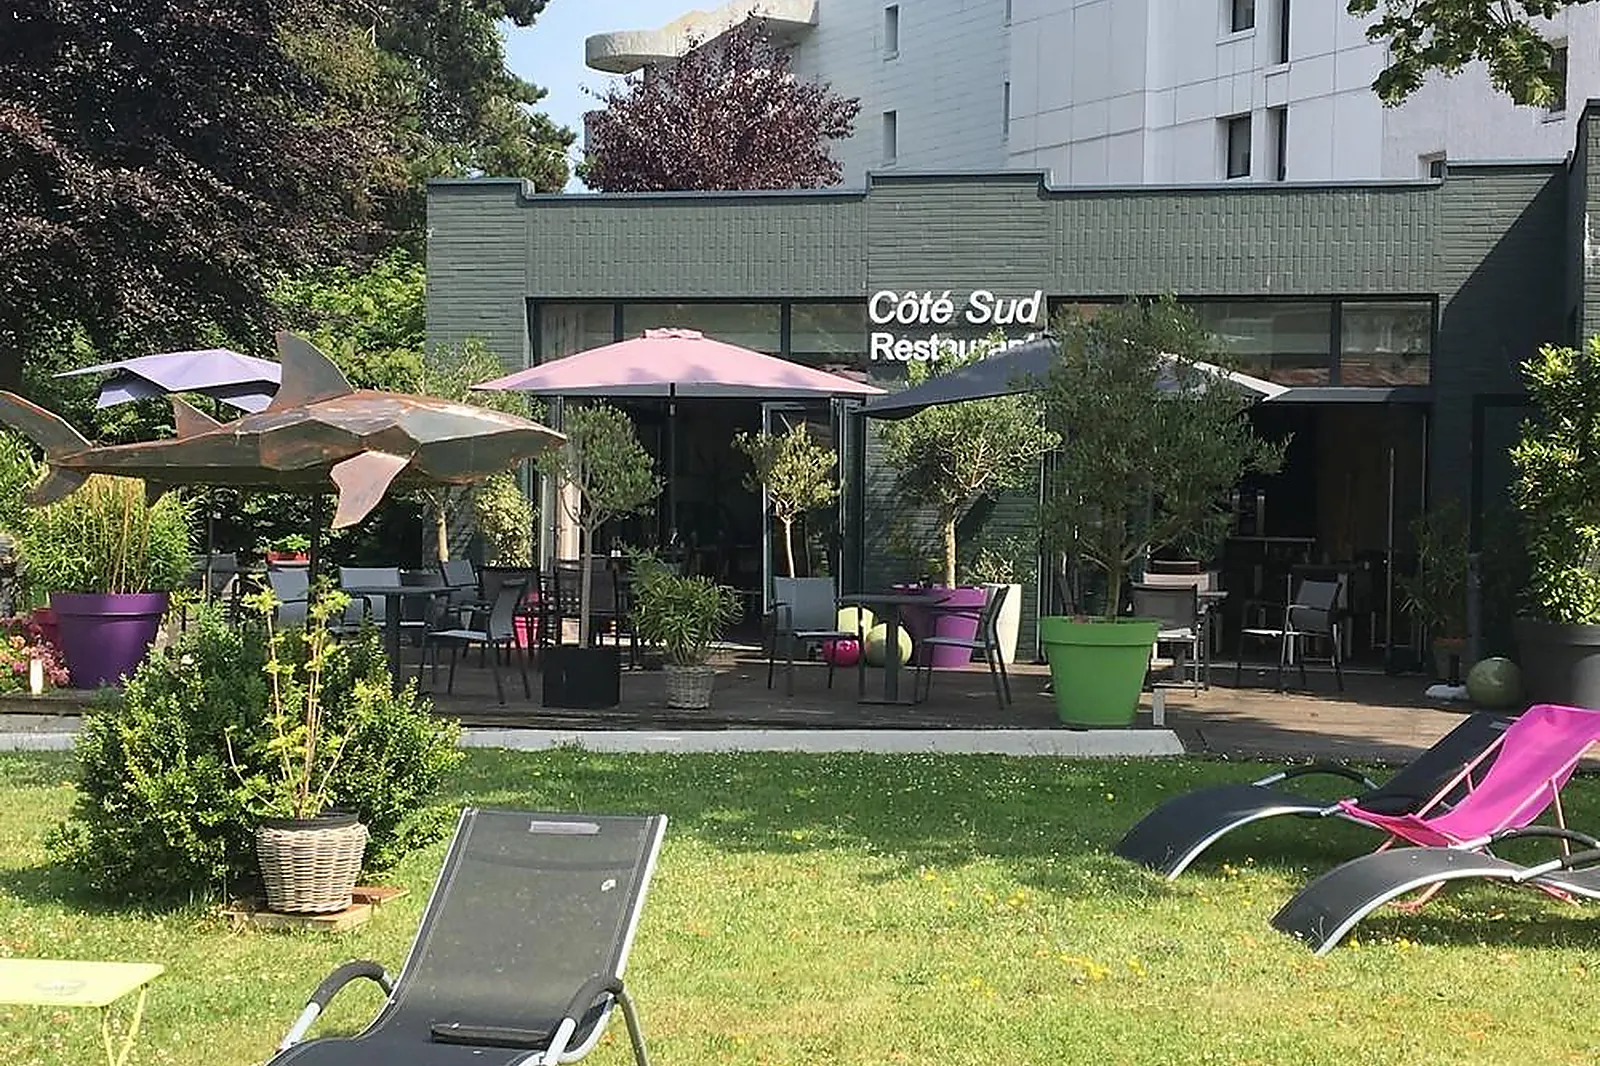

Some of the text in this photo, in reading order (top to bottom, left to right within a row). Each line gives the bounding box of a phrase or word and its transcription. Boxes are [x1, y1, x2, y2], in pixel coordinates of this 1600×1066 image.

[868, 290, 1042, 325] Côté Sud
[870, 332, 1037, 362] Restaura
